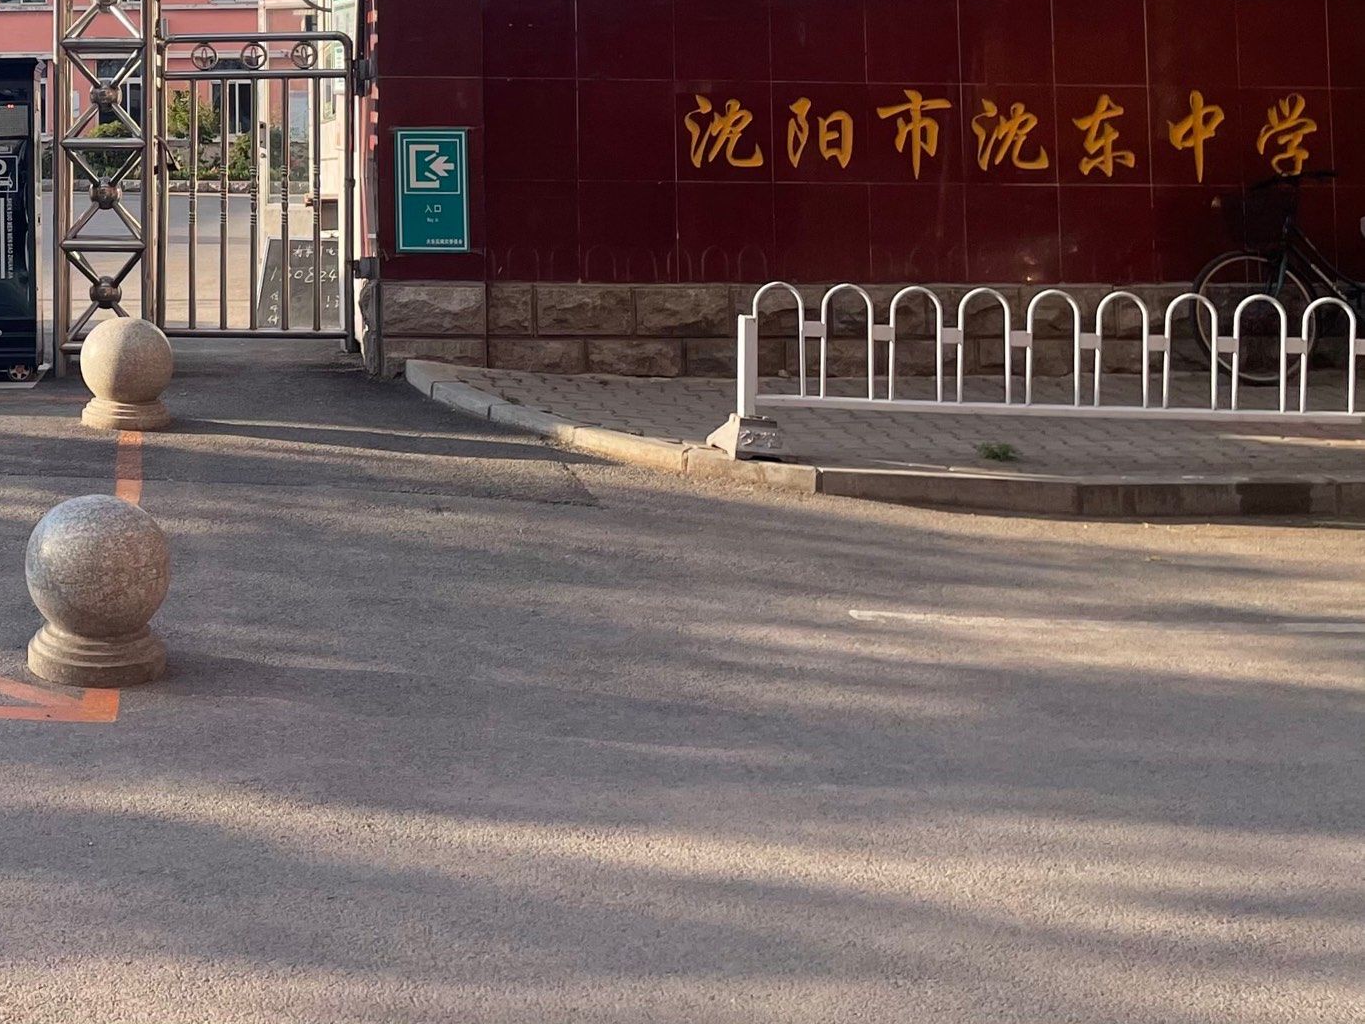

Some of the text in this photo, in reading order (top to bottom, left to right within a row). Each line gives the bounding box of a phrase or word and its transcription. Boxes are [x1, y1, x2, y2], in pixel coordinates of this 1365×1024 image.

[684, 89, 1317, 183] 沈阳市沈东中学
[425, 205, 442, 213] 入口
